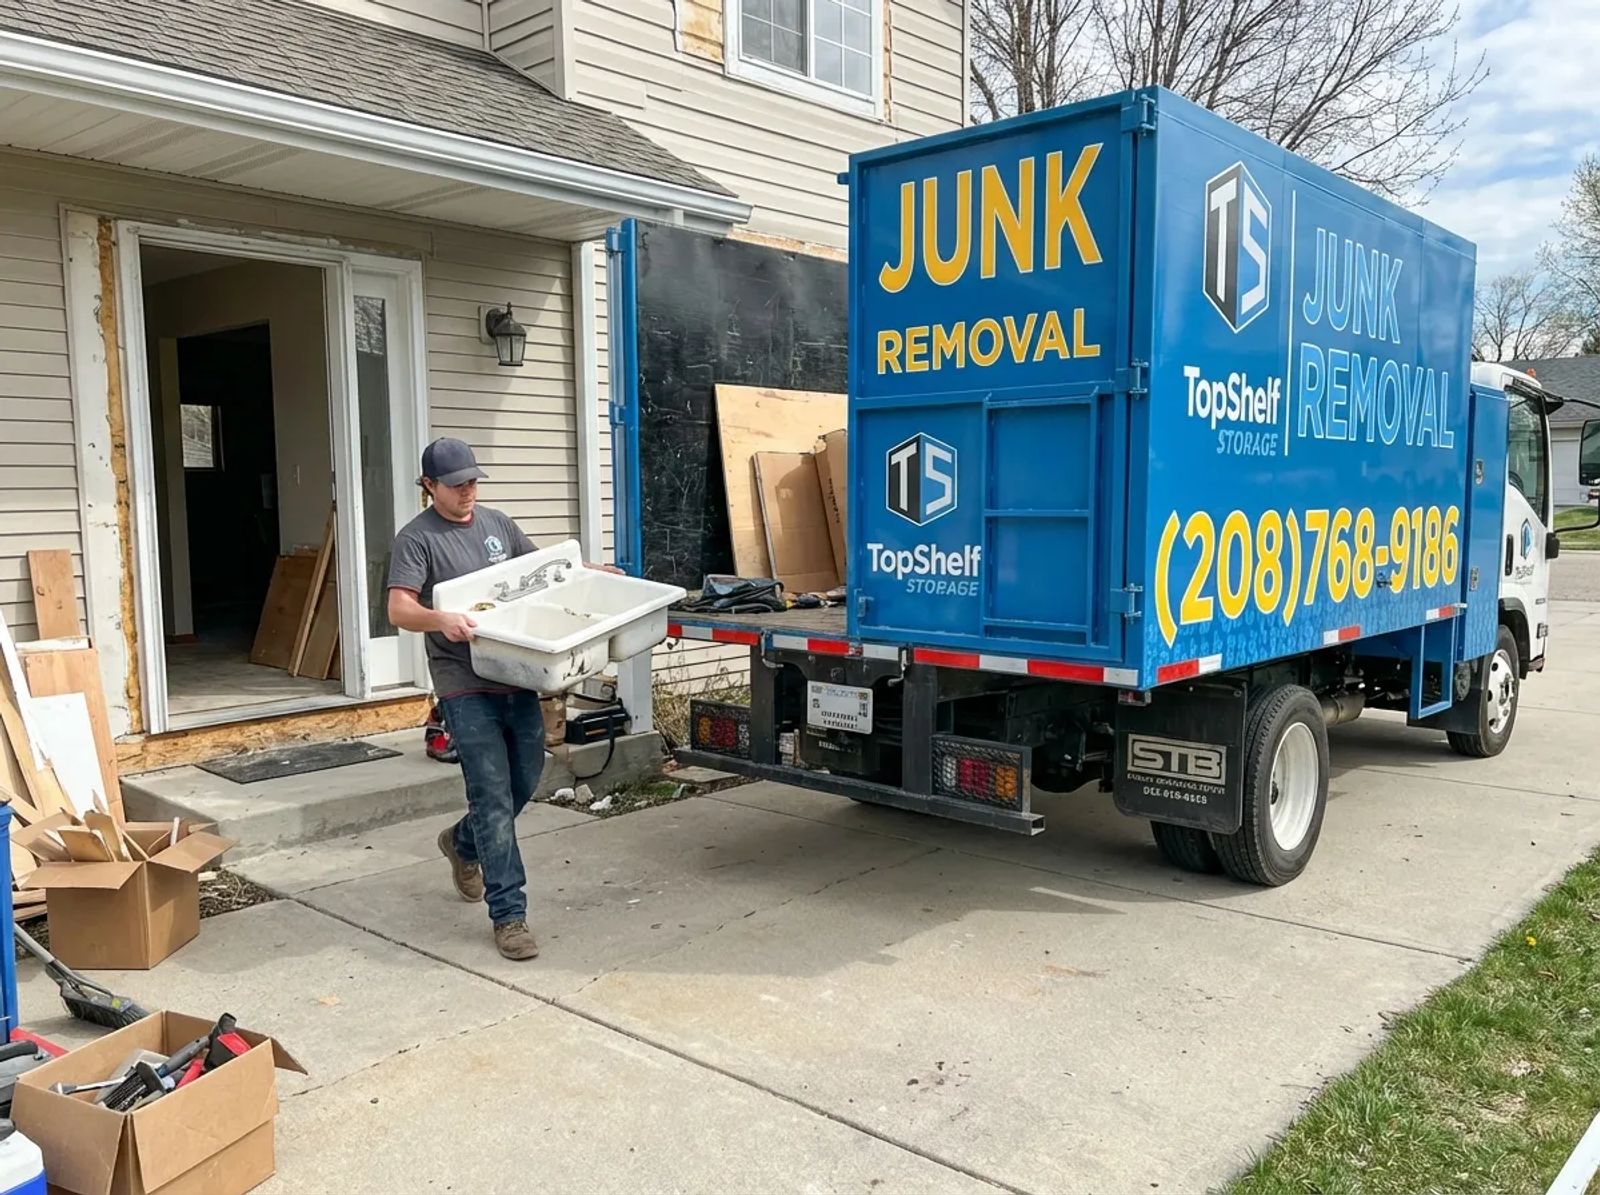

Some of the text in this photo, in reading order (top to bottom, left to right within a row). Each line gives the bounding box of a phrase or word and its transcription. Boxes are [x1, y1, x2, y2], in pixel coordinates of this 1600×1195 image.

[879, 142, 1104, 293] JUNK
[1210, 177, 1268, 315] TS
[1302, 227, 1403, 344] JUNK
[877, 308, 1101, 375] REMOVAL
[1183, 365, 1281, 430] TopShelf
[1298, 342, 1454, 448] REMOVAL
[1216, 429, 1279, 456] STORAGE
[890, 442, 953, 516] TS
[867, 543, 982, 580] TopShelf
[906, 579, 979, 596] STORAGE
[1132, 740, 1221, 778] STB
